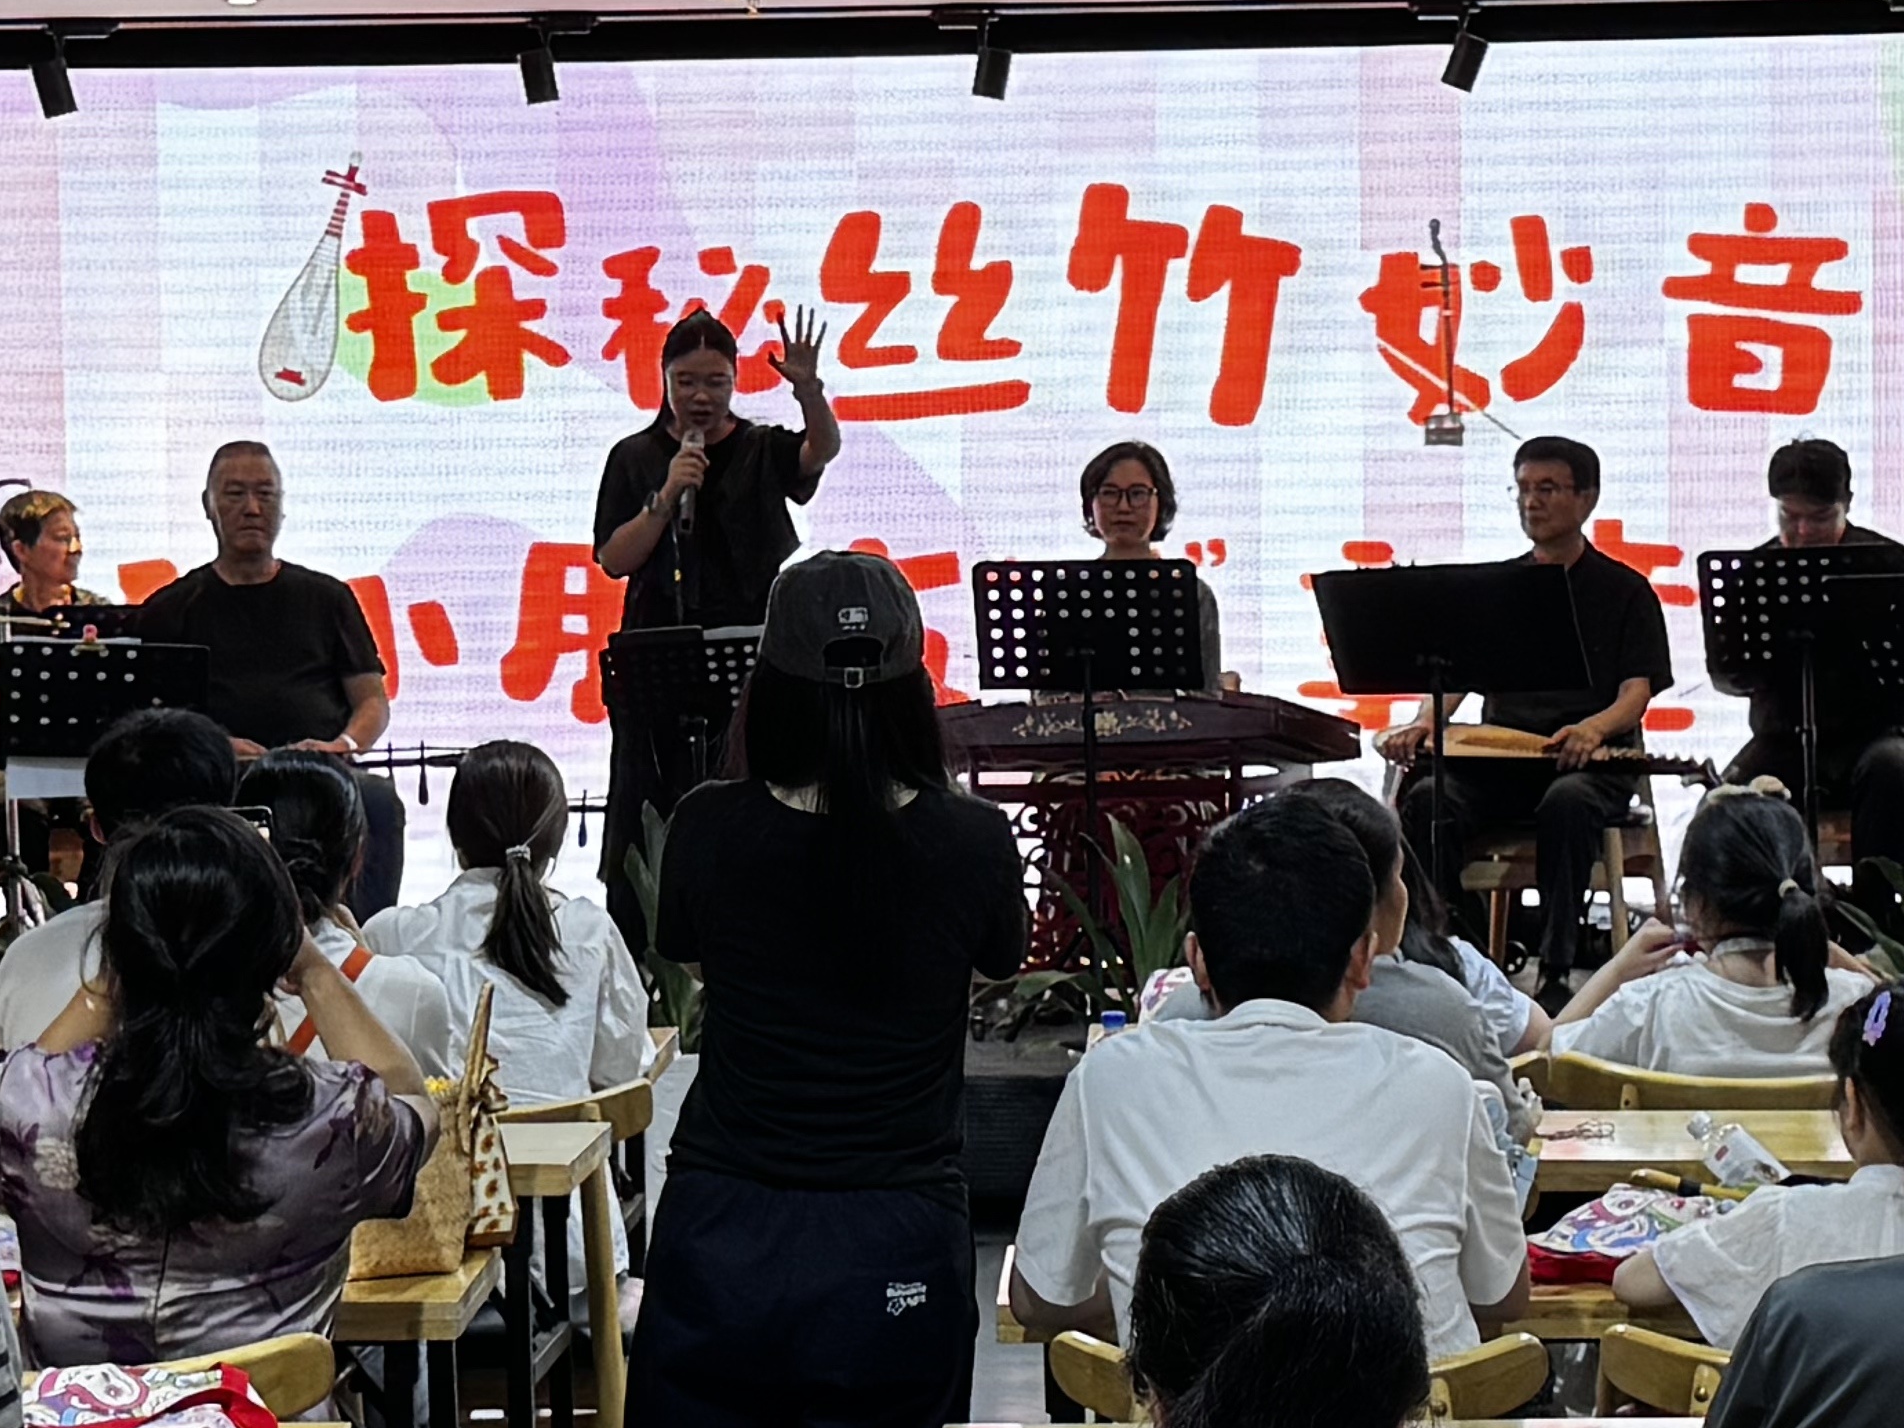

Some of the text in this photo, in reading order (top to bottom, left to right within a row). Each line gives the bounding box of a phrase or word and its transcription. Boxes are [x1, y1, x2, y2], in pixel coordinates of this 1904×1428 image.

[345, 182, 1863, 426] 探秘丝竹妙音
